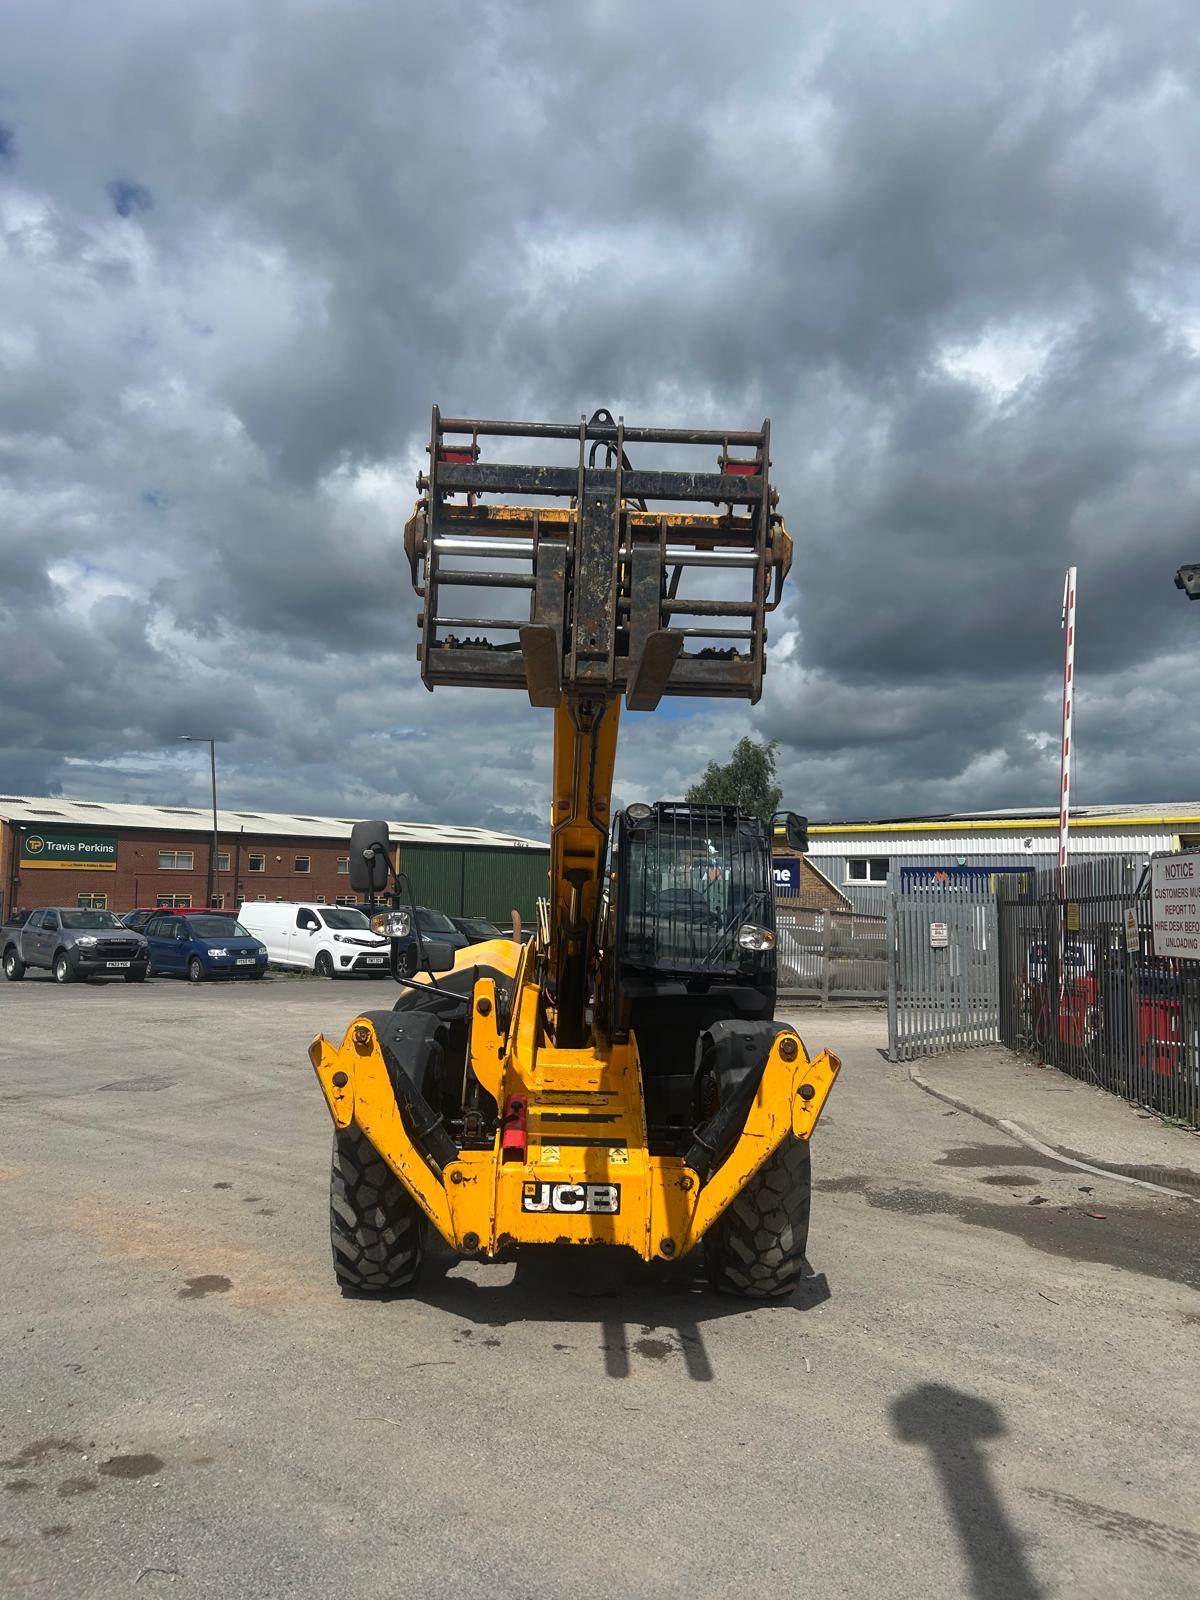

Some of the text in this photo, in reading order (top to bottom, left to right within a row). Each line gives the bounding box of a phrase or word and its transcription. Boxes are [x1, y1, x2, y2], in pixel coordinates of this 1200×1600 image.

[46, 841, 114, 853] Travis Perkins
[1165, 863, 1194, 878] NOTICE
[1154, 888, 1189, 899] CUSTOMERS
[1165, 904, 1196, 915] REPORT TO
[1154, 921, 1168, 931] HIRE
[1169, 922, 1184, 931] DESK
[1165, 938, 1198, 949] UNLOADING
[524, 1184, 618, 1212] JCB
